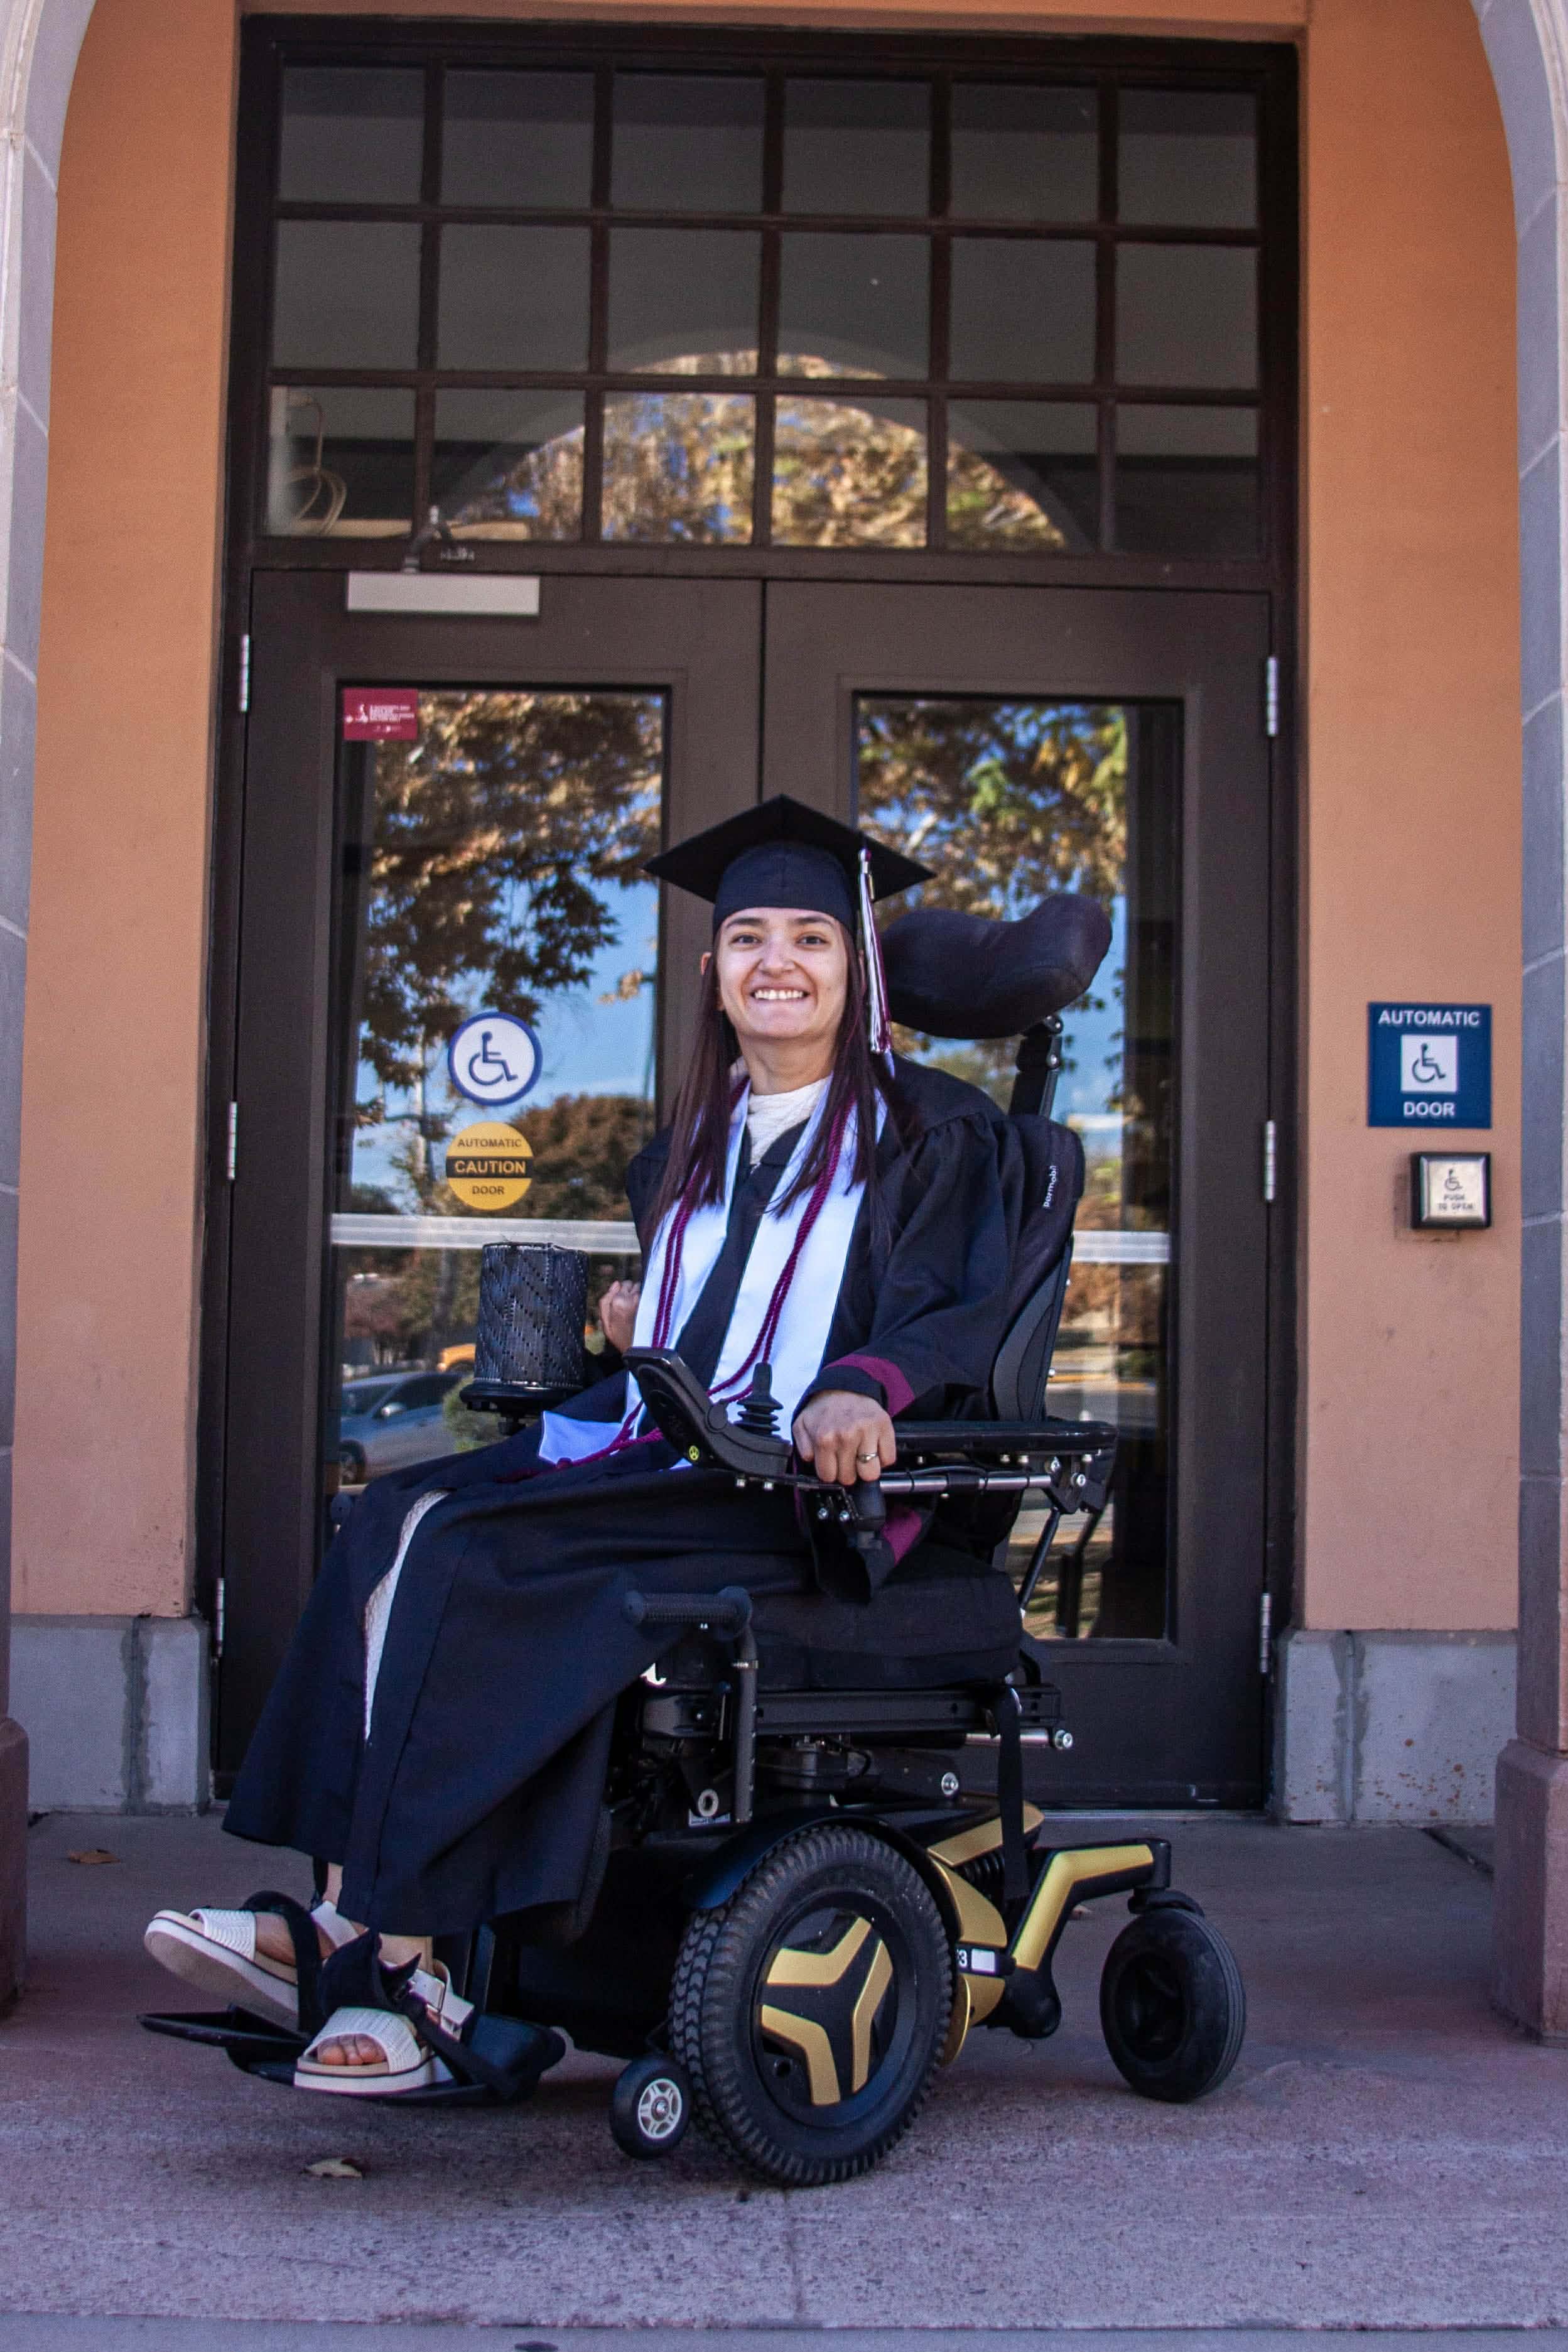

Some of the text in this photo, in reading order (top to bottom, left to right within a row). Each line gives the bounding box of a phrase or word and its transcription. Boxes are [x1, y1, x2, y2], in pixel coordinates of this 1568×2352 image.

[1378, 1010, 1480, 1026] AUTOMATIC
[1403, 1102, 1456, 1117] DOOR
[457, 1139, 522, 1147] AUTOMATIC
[455, 1160, 526, 1174] CAUTION
[472, 1185, 505, 1195] DOOR
[1043, 1164, 1057, 1207] permobil
